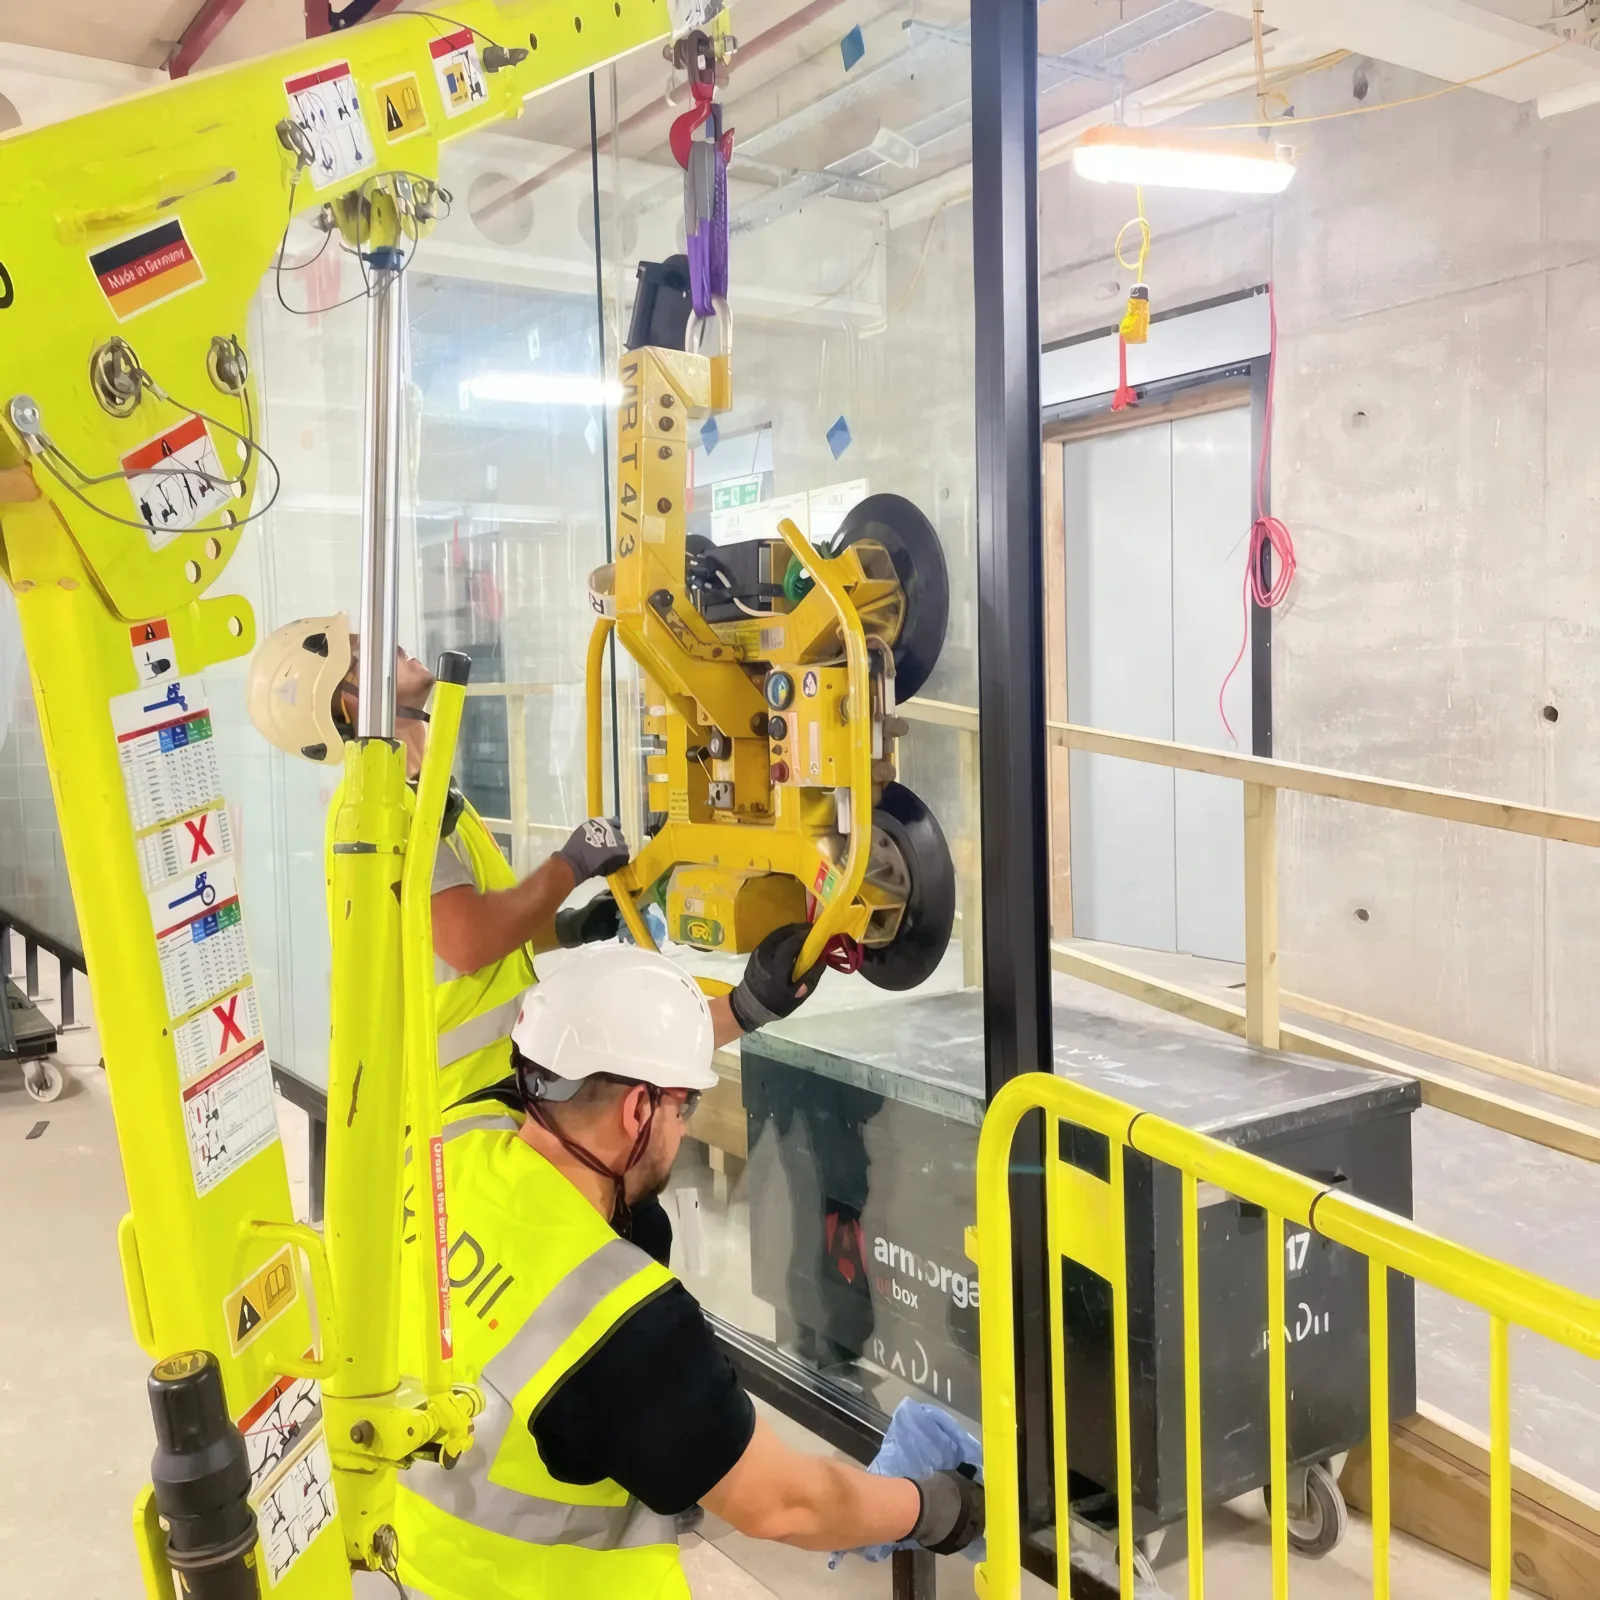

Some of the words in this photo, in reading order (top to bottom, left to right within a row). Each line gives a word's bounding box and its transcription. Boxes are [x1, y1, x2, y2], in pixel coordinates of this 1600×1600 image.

[873, 1235, 980, 1309] armorga
[1286, 1231, 1310, 1271] 17
[876, 1277, 919, 1310] box
[873, 1337, 952, 1403] RADII
